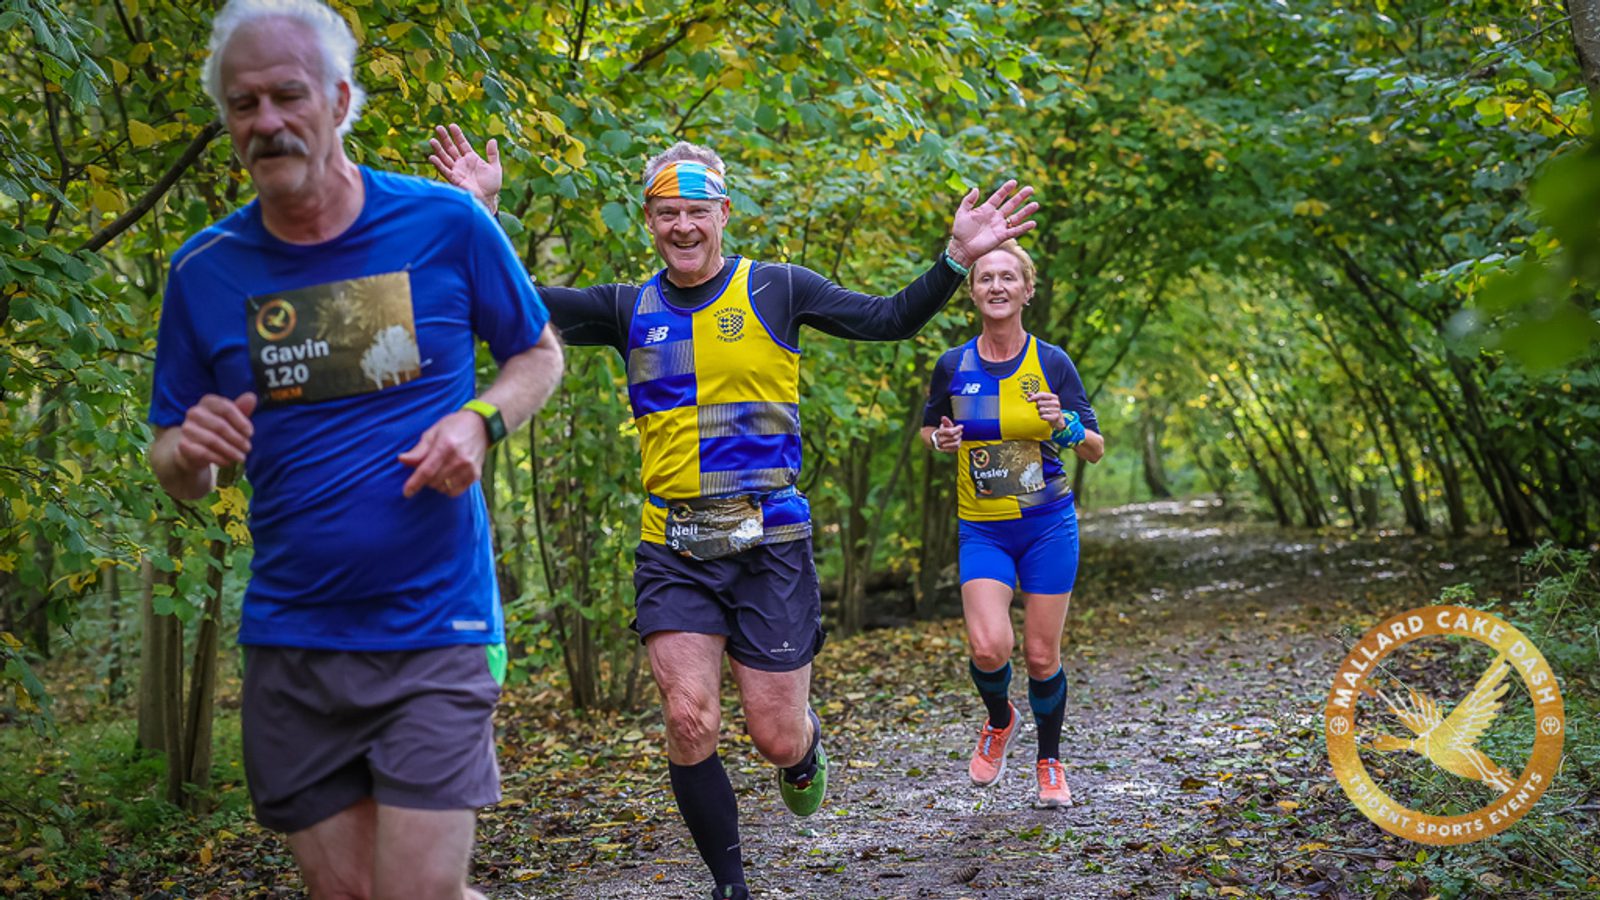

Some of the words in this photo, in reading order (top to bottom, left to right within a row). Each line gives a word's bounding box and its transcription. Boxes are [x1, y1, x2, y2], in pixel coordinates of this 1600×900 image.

[261, 339, 329, 365] Gavin
[264, 363, 309, 388] 120
[974, 468, 1009, 479] Lesley
[671, 523, 698, 537] Neil
[671, 540, 680, 550] 9
